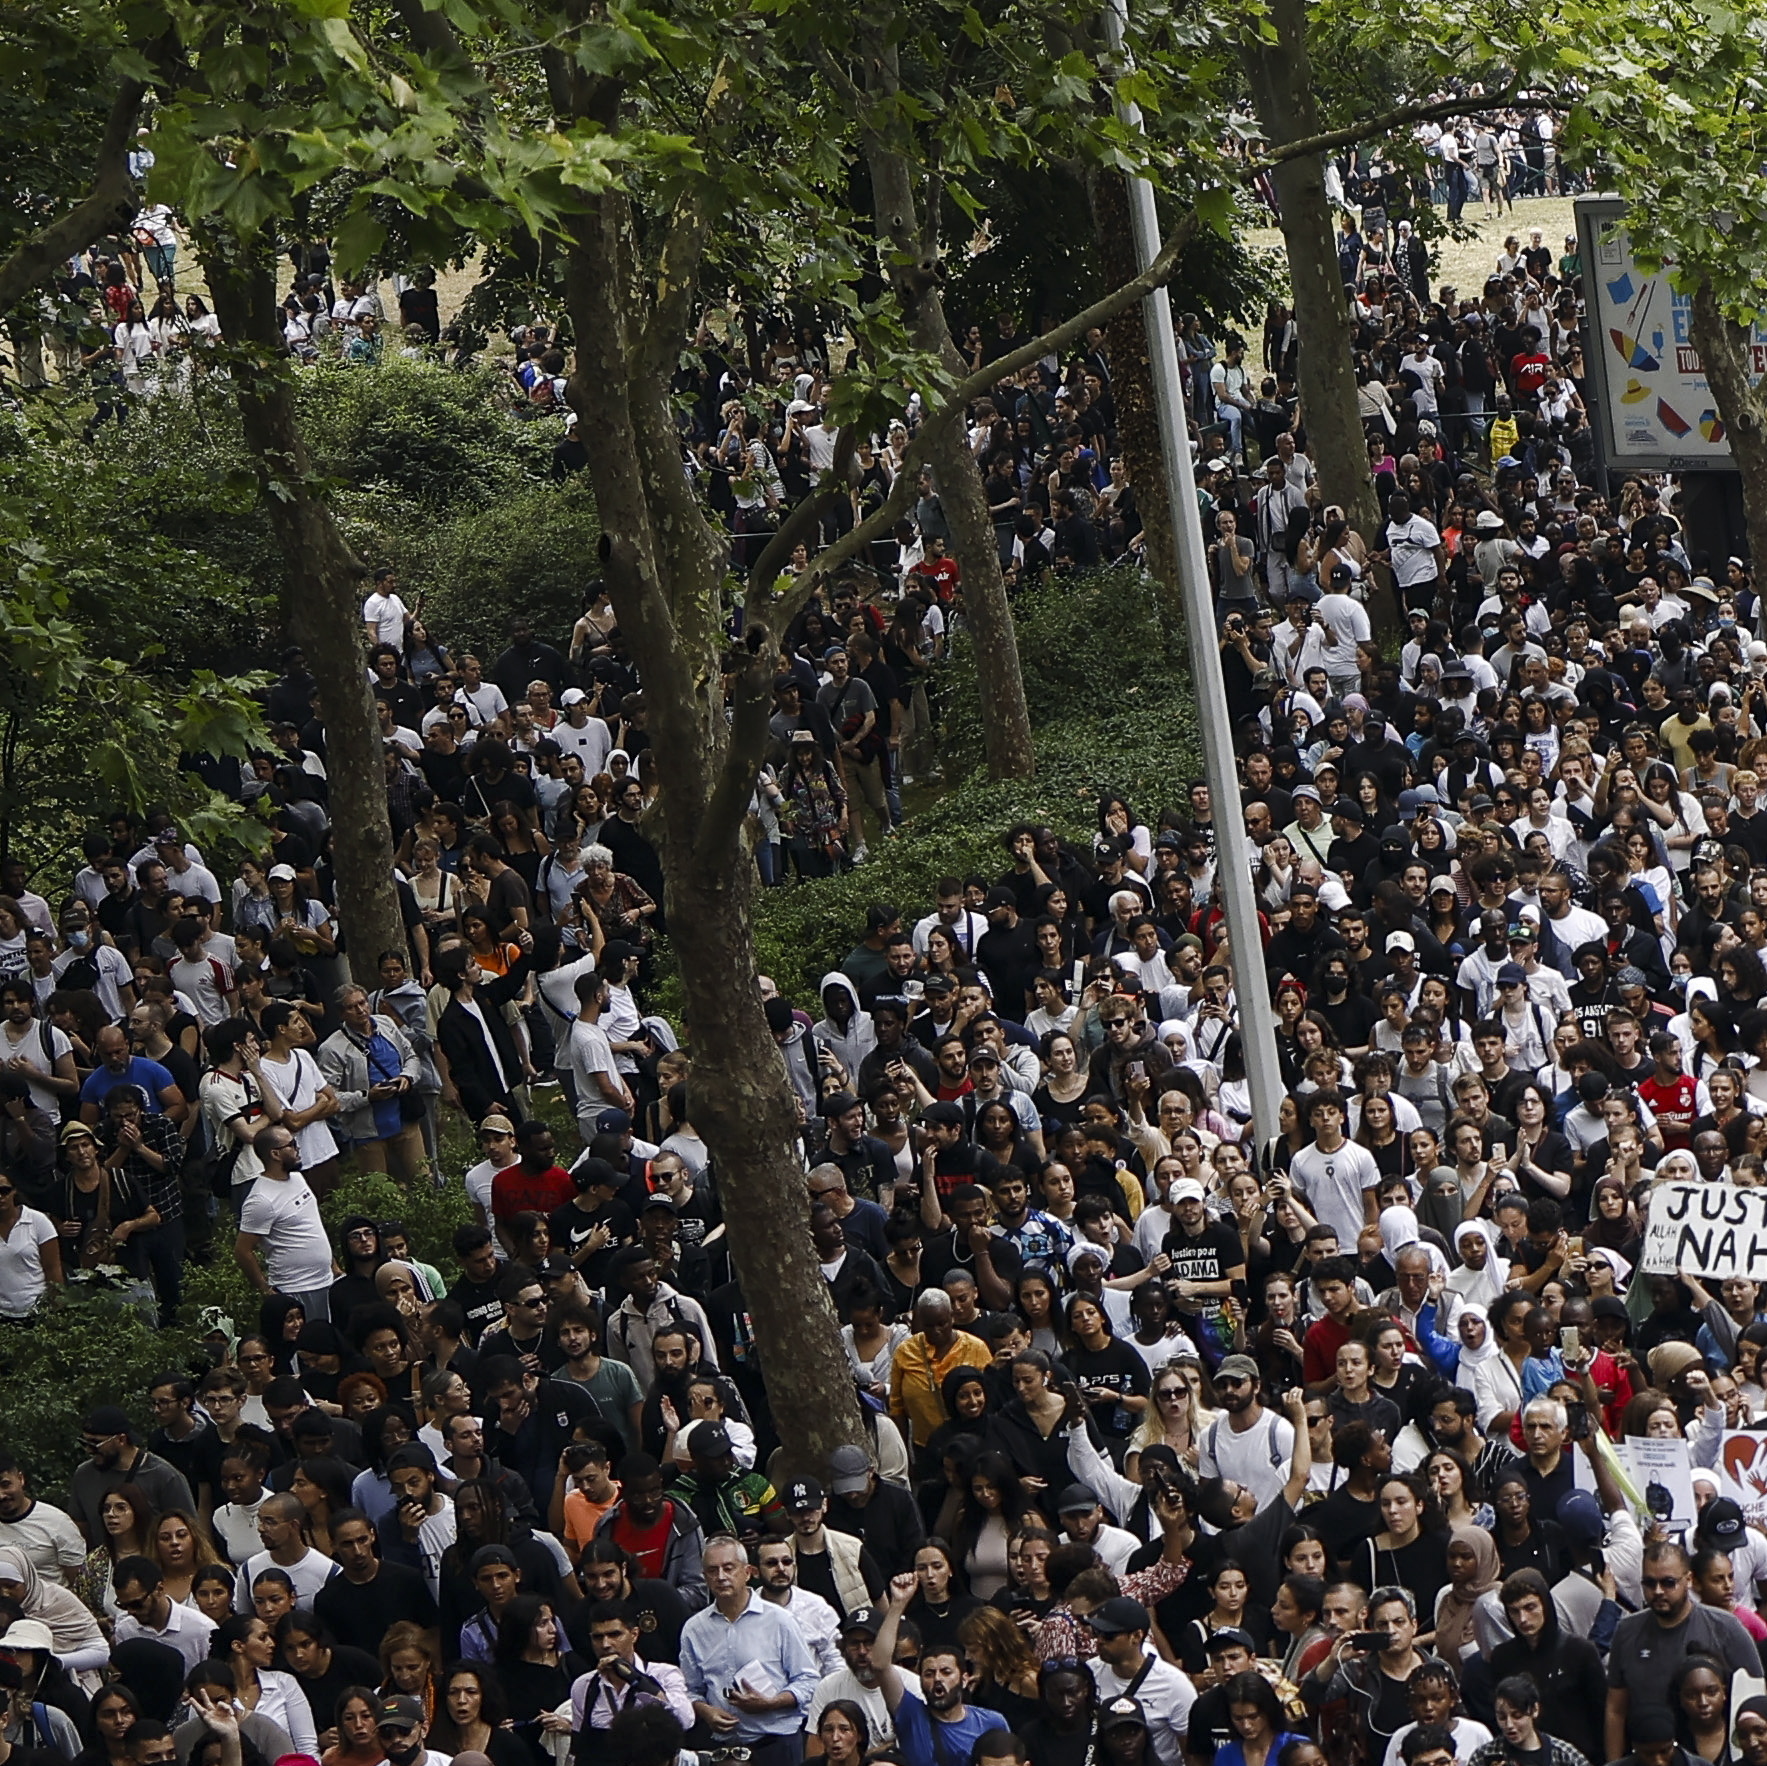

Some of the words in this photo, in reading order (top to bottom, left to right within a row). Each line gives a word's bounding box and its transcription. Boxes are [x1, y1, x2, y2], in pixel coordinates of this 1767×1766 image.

[1649, 1224, 1677, 1239] ALLAH
[1172, 1248, 1196, 1260] Justice
[1198, 1247, 1217, 1260] pour
[1174, 1260, 1218, 1280] ADAMA
[1092, 1374, 1120, 1385] PS5
[857, 1609, 869, 1622] B
